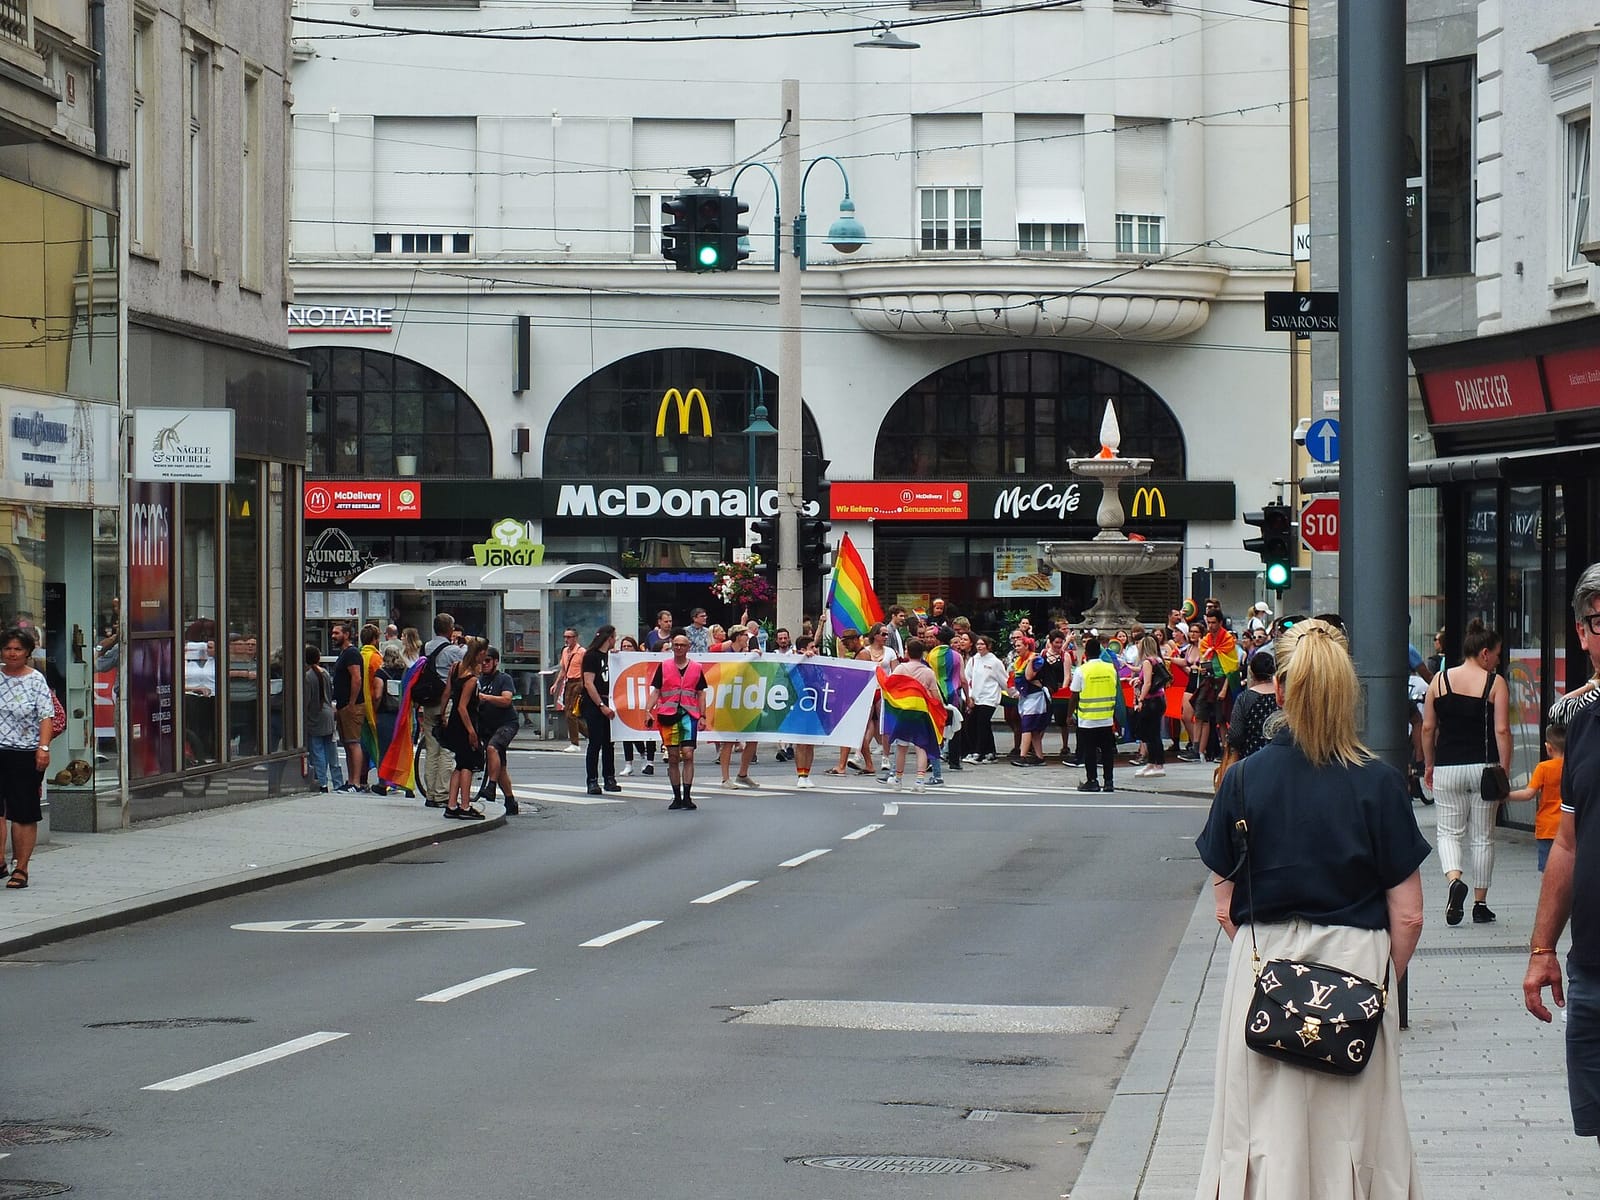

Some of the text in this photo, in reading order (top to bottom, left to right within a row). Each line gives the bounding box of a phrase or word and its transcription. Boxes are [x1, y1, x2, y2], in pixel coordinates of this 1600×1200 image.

[288, 307, 392, 326] NOTARE
[1271, 315, 1337, 329] SWAROVSK
[177, 445, 211, 454] NÄGELE
[152, 451, 211, 463] & STRUBELL
[334, 491, 381, 501] McDelivery
[556, 484, 820, 517] McDonals
[994, 483, 1080, 519] McCafé
[836, 505, 850, 513] Wir
[1305, 514, 1337, 536] STO
[307, 550, 360, 562] AUINGER
[427, 579, 467, 587] Taubenmarkt
[626, 676, 834, 713] liride.at
